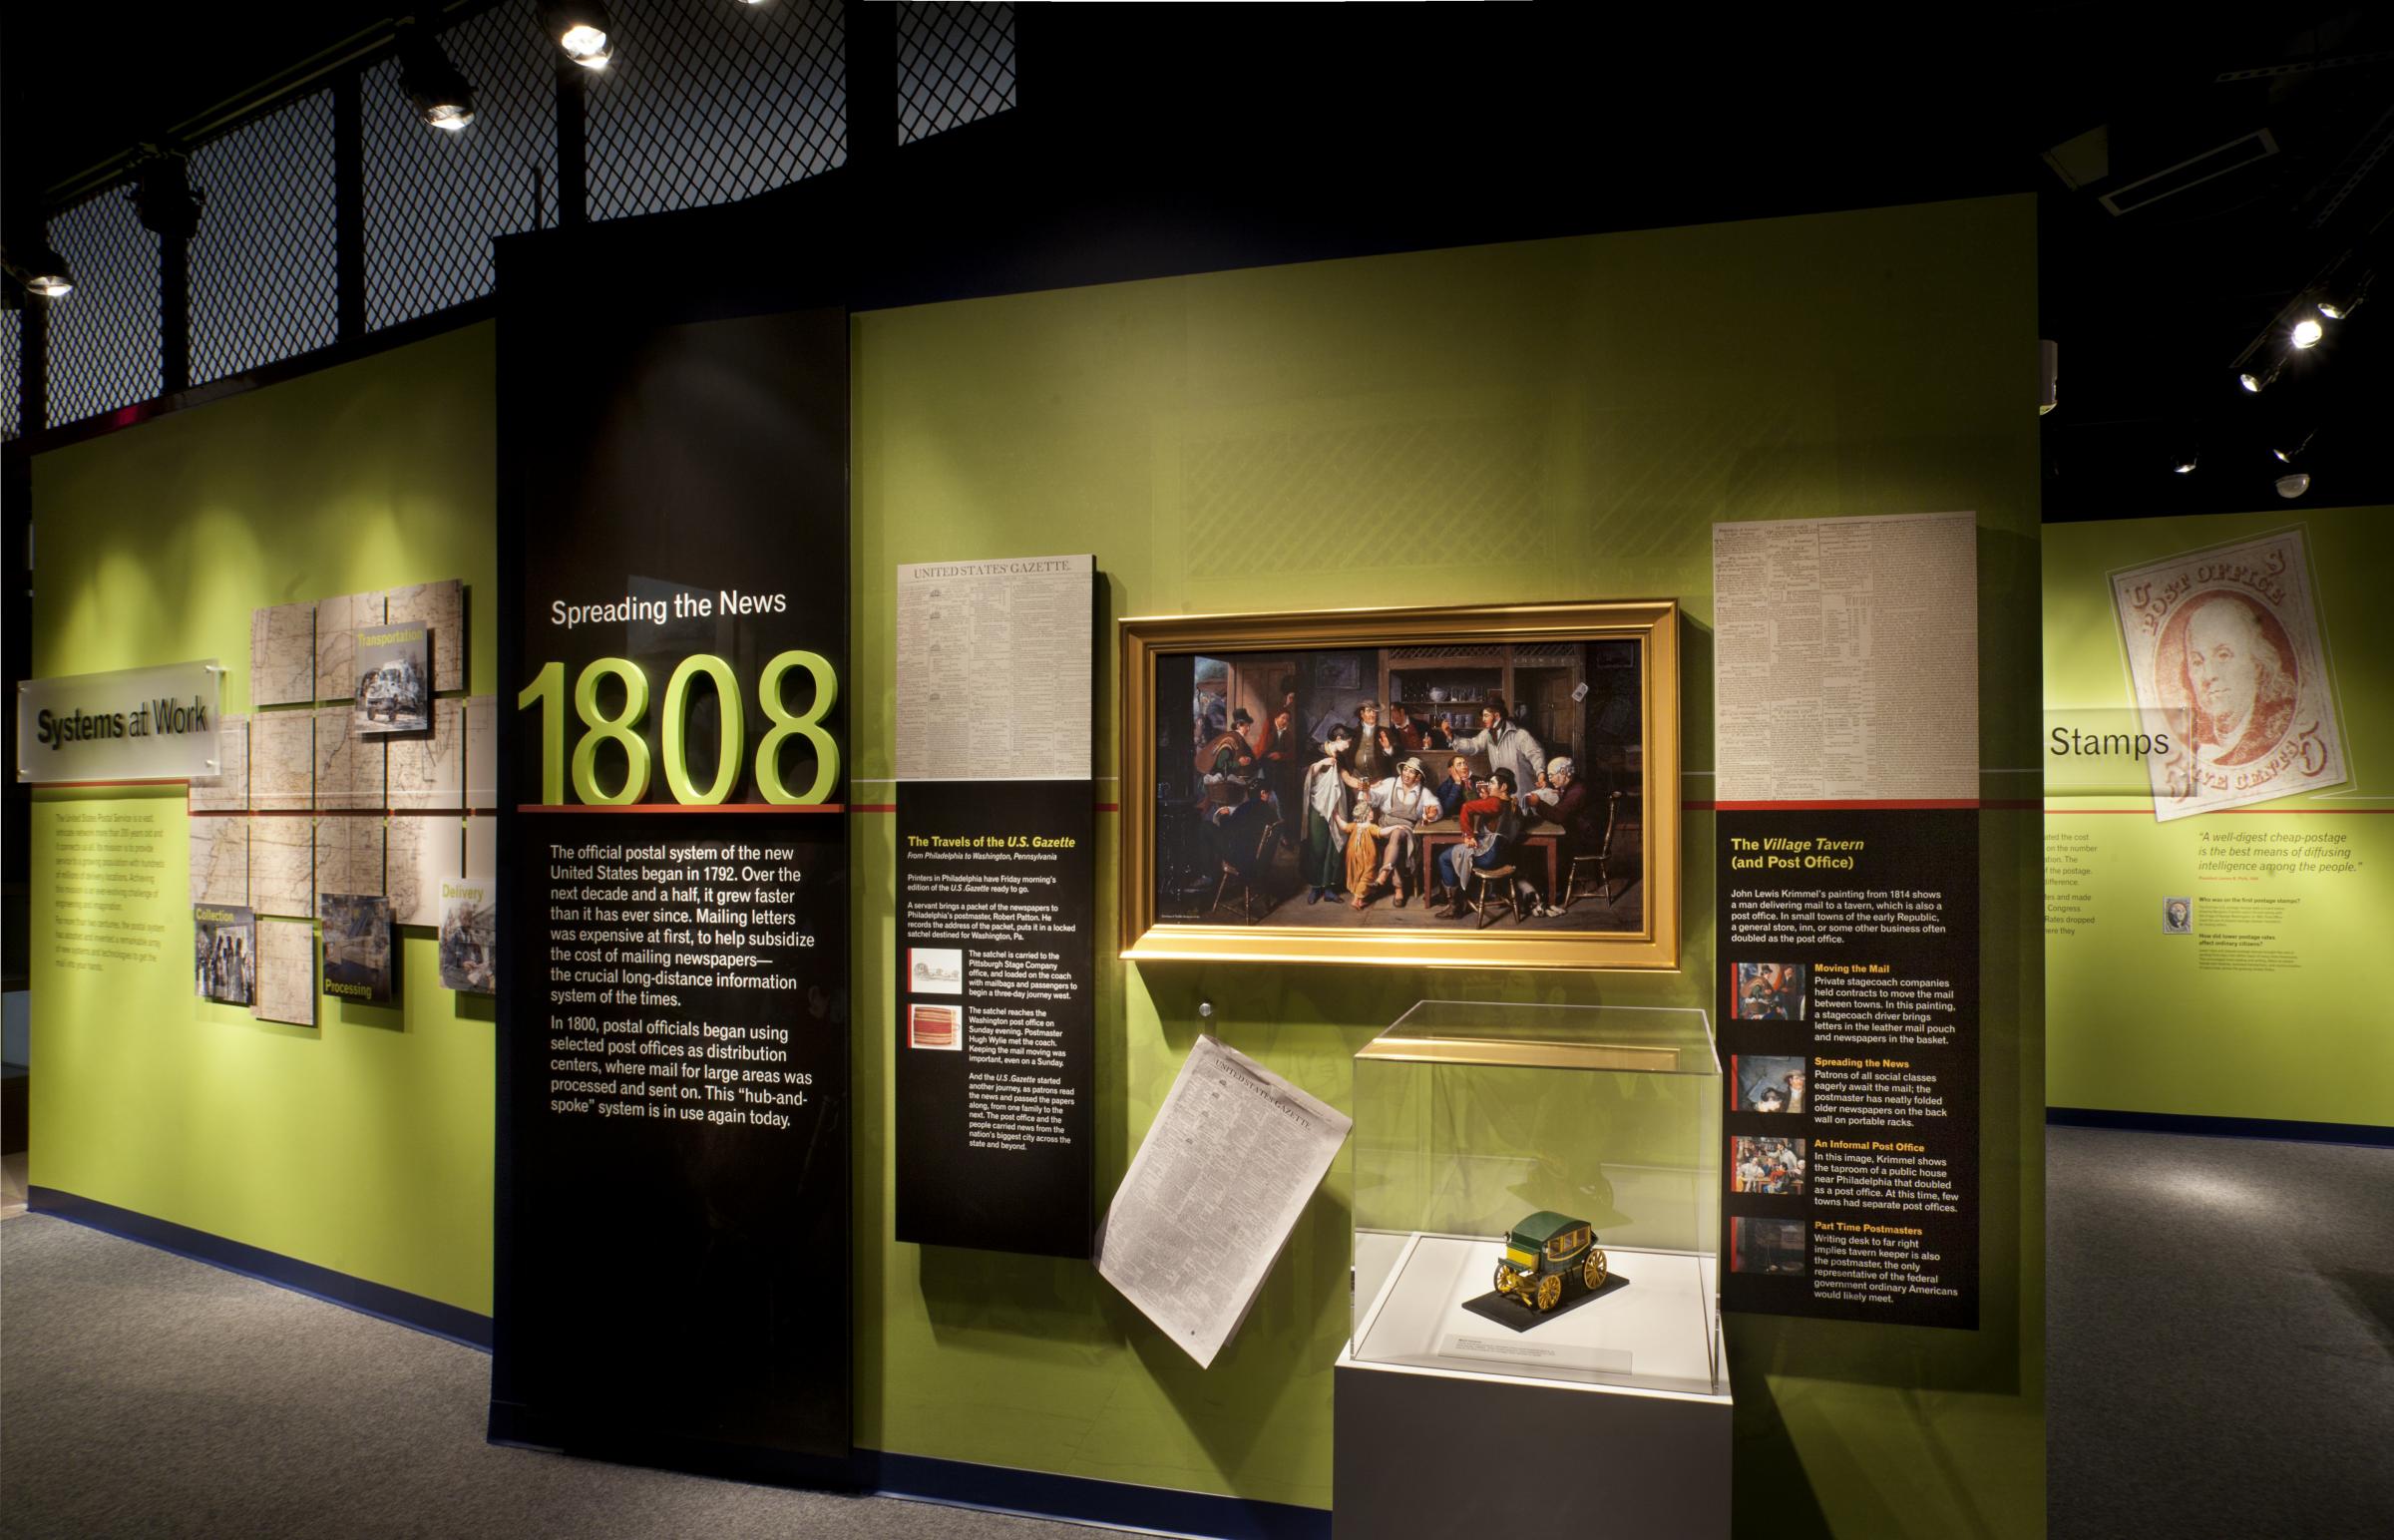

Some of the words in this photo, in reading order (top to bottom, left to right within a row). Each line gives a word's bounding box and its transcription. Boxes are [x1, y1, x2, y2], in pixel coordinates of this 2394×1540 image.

[914, 567, 959, 578] UNITED
[2143, 573, 2192, 636] POST
[2197, 564, 2286, 606] OFFICE
[551, 596, 666, 629] Spreading
[673, 592, 711, 618] the
[719, 590, 786, 615] News
[358, 628, 423, 647] Transportation
[37, 708, 124, 750] Systems
[129, 702, 149, 737] at
[153, 694, 207, 734] Work
[518, 650, 841, 806] 1808
[2050, 726, 2169, 760] Stamps
[908, 836, 929, 847] The
[932, 836, 971, 847] Travels
[973, 836, 984, 848] of
[986, 836, 1004, 848] the
[1006, 836, 1028, 848] U.S.
[1031, 836, 1075, 848] Gazette
[1731, 838, 1759, 851] The
[1764, 838, 1811, 853] Village
[1816, 838, 1863, 850] Tavern
[2212, 832, 2266, 844] well-digest
[2269, 832, 2348, 844] cheap-postage
[551, 844, 575, 860] The
[577, 845, 620, 860] official
[624, 845, 665, 862] postal
[667, 845, 718, 864] system
[721, 844, 735, 860] of
[738, 844, 760, 860] the
[764, 849, 794, 860] new
[925, 852, 963, 861] Philadelphia
[973, 853, 1011, 862] Washington,
[1013, 853, 1056, 862] Pennsylvania
[2209, 846, 2226, 857] the
[2228, 847, 2250, 856] best
[2290, 847, 2301, 858] of
[2304, 847, 2351, 860] diffusing
[1731, 856, 1763, 870] (and
[1768, 856, 1800, 869] Post
[1803, 856, 1853, 870] Office)
[2197, 861, 2256, 873] intelligence
[2258, 863, 2296, 874] among
[2298, 862, 2316, 872] the
[551, 866, 593, 880] United
[597, 865, 638, 881] States
[641, 866, 682, 884] began
[686, 866, 699, 881] in
[702, 866, 737, 882] 1792.
[741, 866, 774, 882] Over
[777, 867, 800, 882] the
[942, 875, 982, 884] Philadelphia
[1000, 875, 1020, 885] Friday
[442, 884, 485, 902] Delivery
[551, 887, 577, 900] next
[581, 886, 627, 901] decade
[631, 887, 655, 902] and
[659, 890, 667, 902] a
[671, 887, 699, 905] half,
[704, 887, 712, 903] it
[716, 891, 750, 906] grew
[754, 888, 794, 904] faster
[1828, 890, 1863, 900] painting
[1890, 890, 1909, 899] 1814
[1912, 890, 1940, 899] shows
[1760, 901, 1801, 911] delivering
[1804, 901, 1822, 910] mail
[1844, 902, 1872, 911] tavern,
[196, 908, 234, 922] Collection
[551, 906, 578, 920] than
[584, 907, 591, 921] it
[596, 907, 617, 922] has
[621, 911, 648, 922] ever
[653, 908, 691, 924] since.
[696, 908, 746, 928] Mailing
[752, 910, 794, 926] letters
[551, 930, 575, 941] was
[579, 931, 643, 945] expensive
[647, 929, 659, 944] at
[663, 929, 693, 947] first,
[697, 930, 710, 945] to
[715, 930, 744, 949] help
[748, 931, 814, 948] subsidize
[550, 947, 571, 961] the
[574, 948, 601, 962] cost
[604, 948, 617, 962] of
[620, 949, 670, 967] mailing
[1048, 952, 1058, 961] the
[1814, 963, 1848, 974] Moving
[1869, 964, 1888, 973] Mail
[550, 967, 571, 981] the
[574, 968, 617, 983] crucial
[622, 969, 712, 987] long-distance
[715, 972, 796, 989] information
[325, 977, 372, 999] Processing
[551, 989, 596, 1004] system
[598, 989, 612, 1003] of
[614, 989, 636, 1004] the
[639, 990, 680, 1006] times.
[1814, 1057, 1862, 1068] Spreading
[1882, 1059, 1908, 1068] News
[1814, 1139, 1826, 1148] An
[1830, 1140, 1868, 1150] Informal
[1872, 1141, 1892, 1151] Post
[1895, 1142, 1924, 1152] Office
[1814, 1221, 1833, 1230] Part
[1837, 1222, 1860, 1232] Time
[1863, 1224, 1921, 1236] Postmasters
